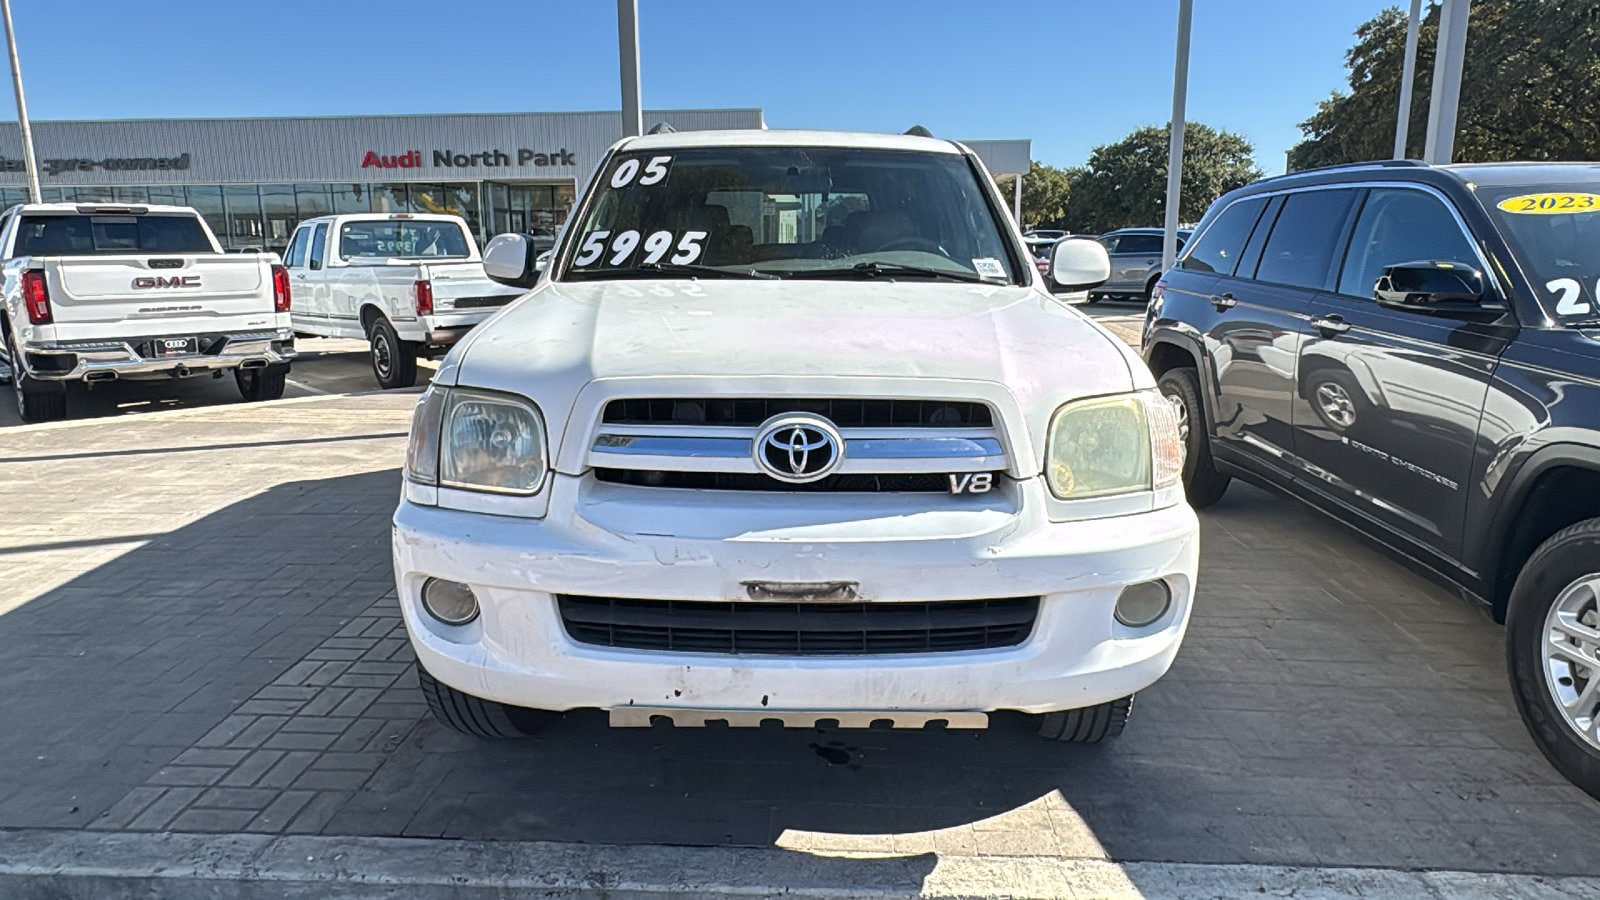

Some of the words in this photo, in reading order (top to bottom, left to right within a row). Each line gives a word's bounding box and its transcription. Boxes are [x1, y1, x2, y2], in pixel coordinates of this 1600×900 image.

[361, 150, 421, 169] Audi
[433, 149, 510, 168] North
[518, 148, 576, 167] Park
[611, 155, 672, 189] 05
[1520, 196, 1594, 211] 2023
[575, 230, 707, 266] 5995
[133, 276, 202, 289] GMC
[1545, 278, 1600, 315] 2
[949, 472, 993, 494] V8
